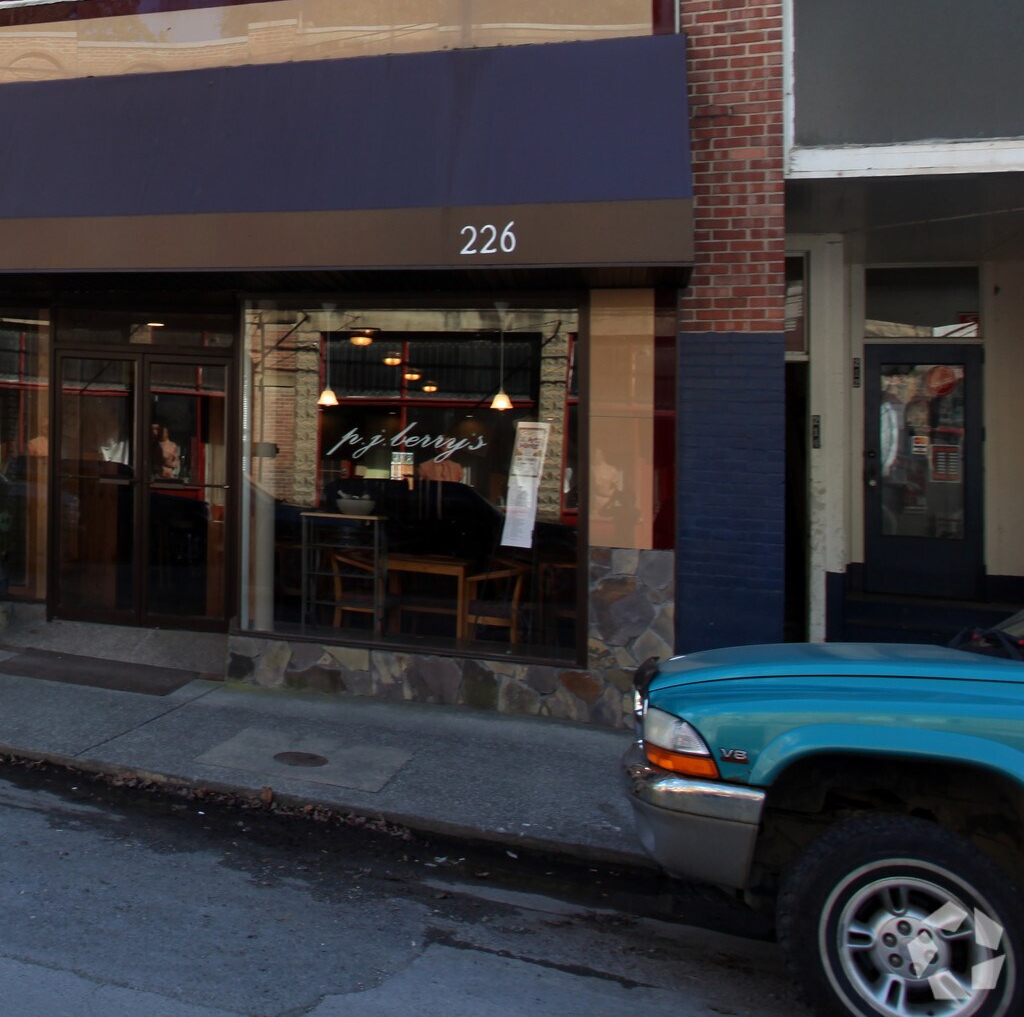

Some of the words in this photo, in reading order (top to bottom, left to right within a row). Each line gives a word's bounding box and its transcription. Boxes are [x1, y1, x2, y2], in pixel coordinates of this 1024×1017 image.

[460, 221, 517, 255] 226
[390, 421, 488, 463] berry's
[720, 748, 748, 760] V8
